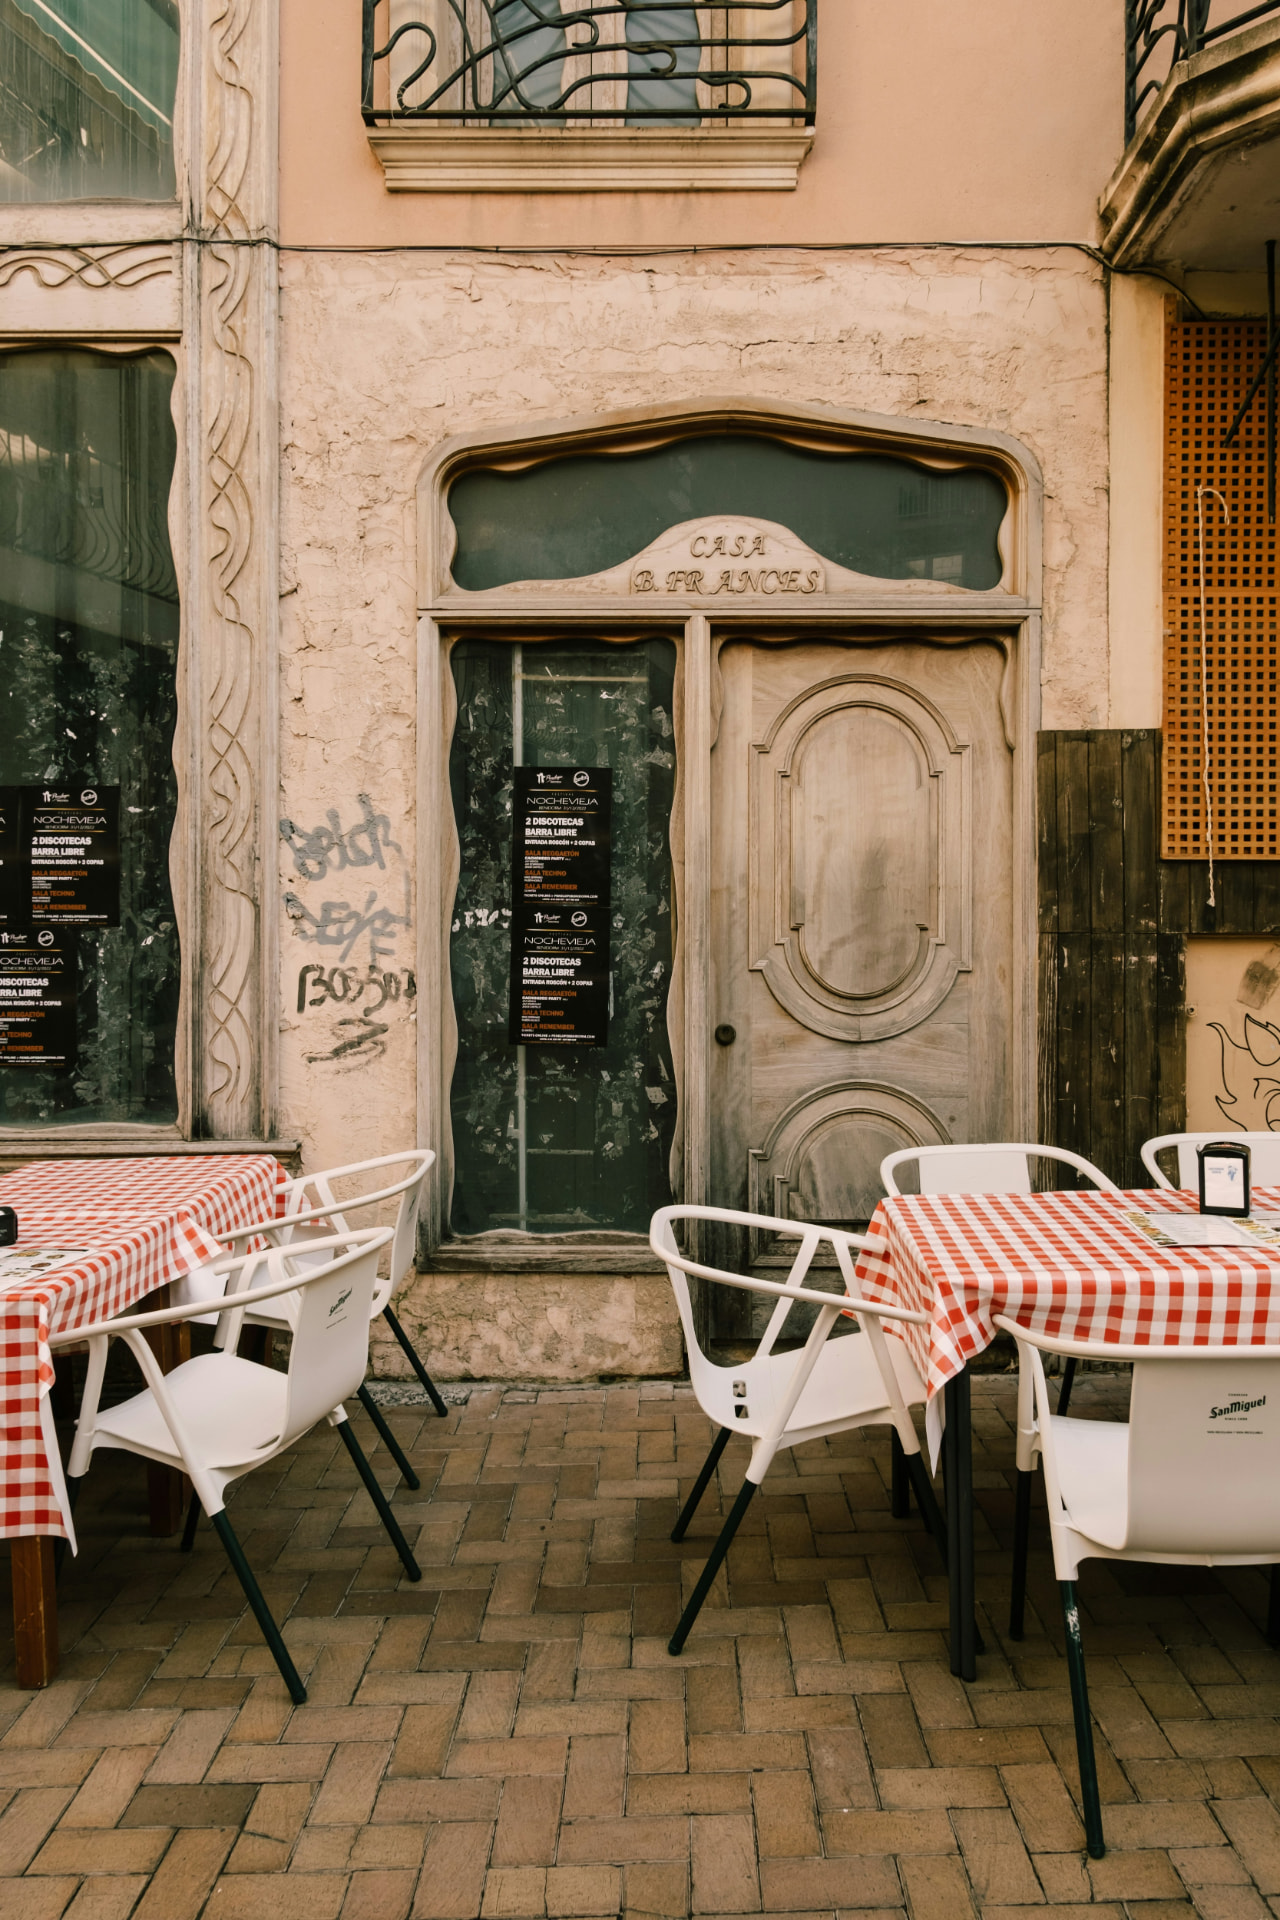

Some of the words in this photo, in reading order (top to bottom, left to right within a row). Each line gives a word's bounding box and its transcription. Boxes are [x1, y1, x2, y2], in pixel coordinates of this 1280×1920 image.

[690, 534, 766, 558] CASA
[633, 569, 659, 593] B.
[533, 818, 584, 826] DISCOTECAS
[524, 937, 596, 946] NOCHEVIEJA
[530, 957, 581, 966] DISCOTECAS
[1208, 1394, 1266, 1419] SanMiguel
